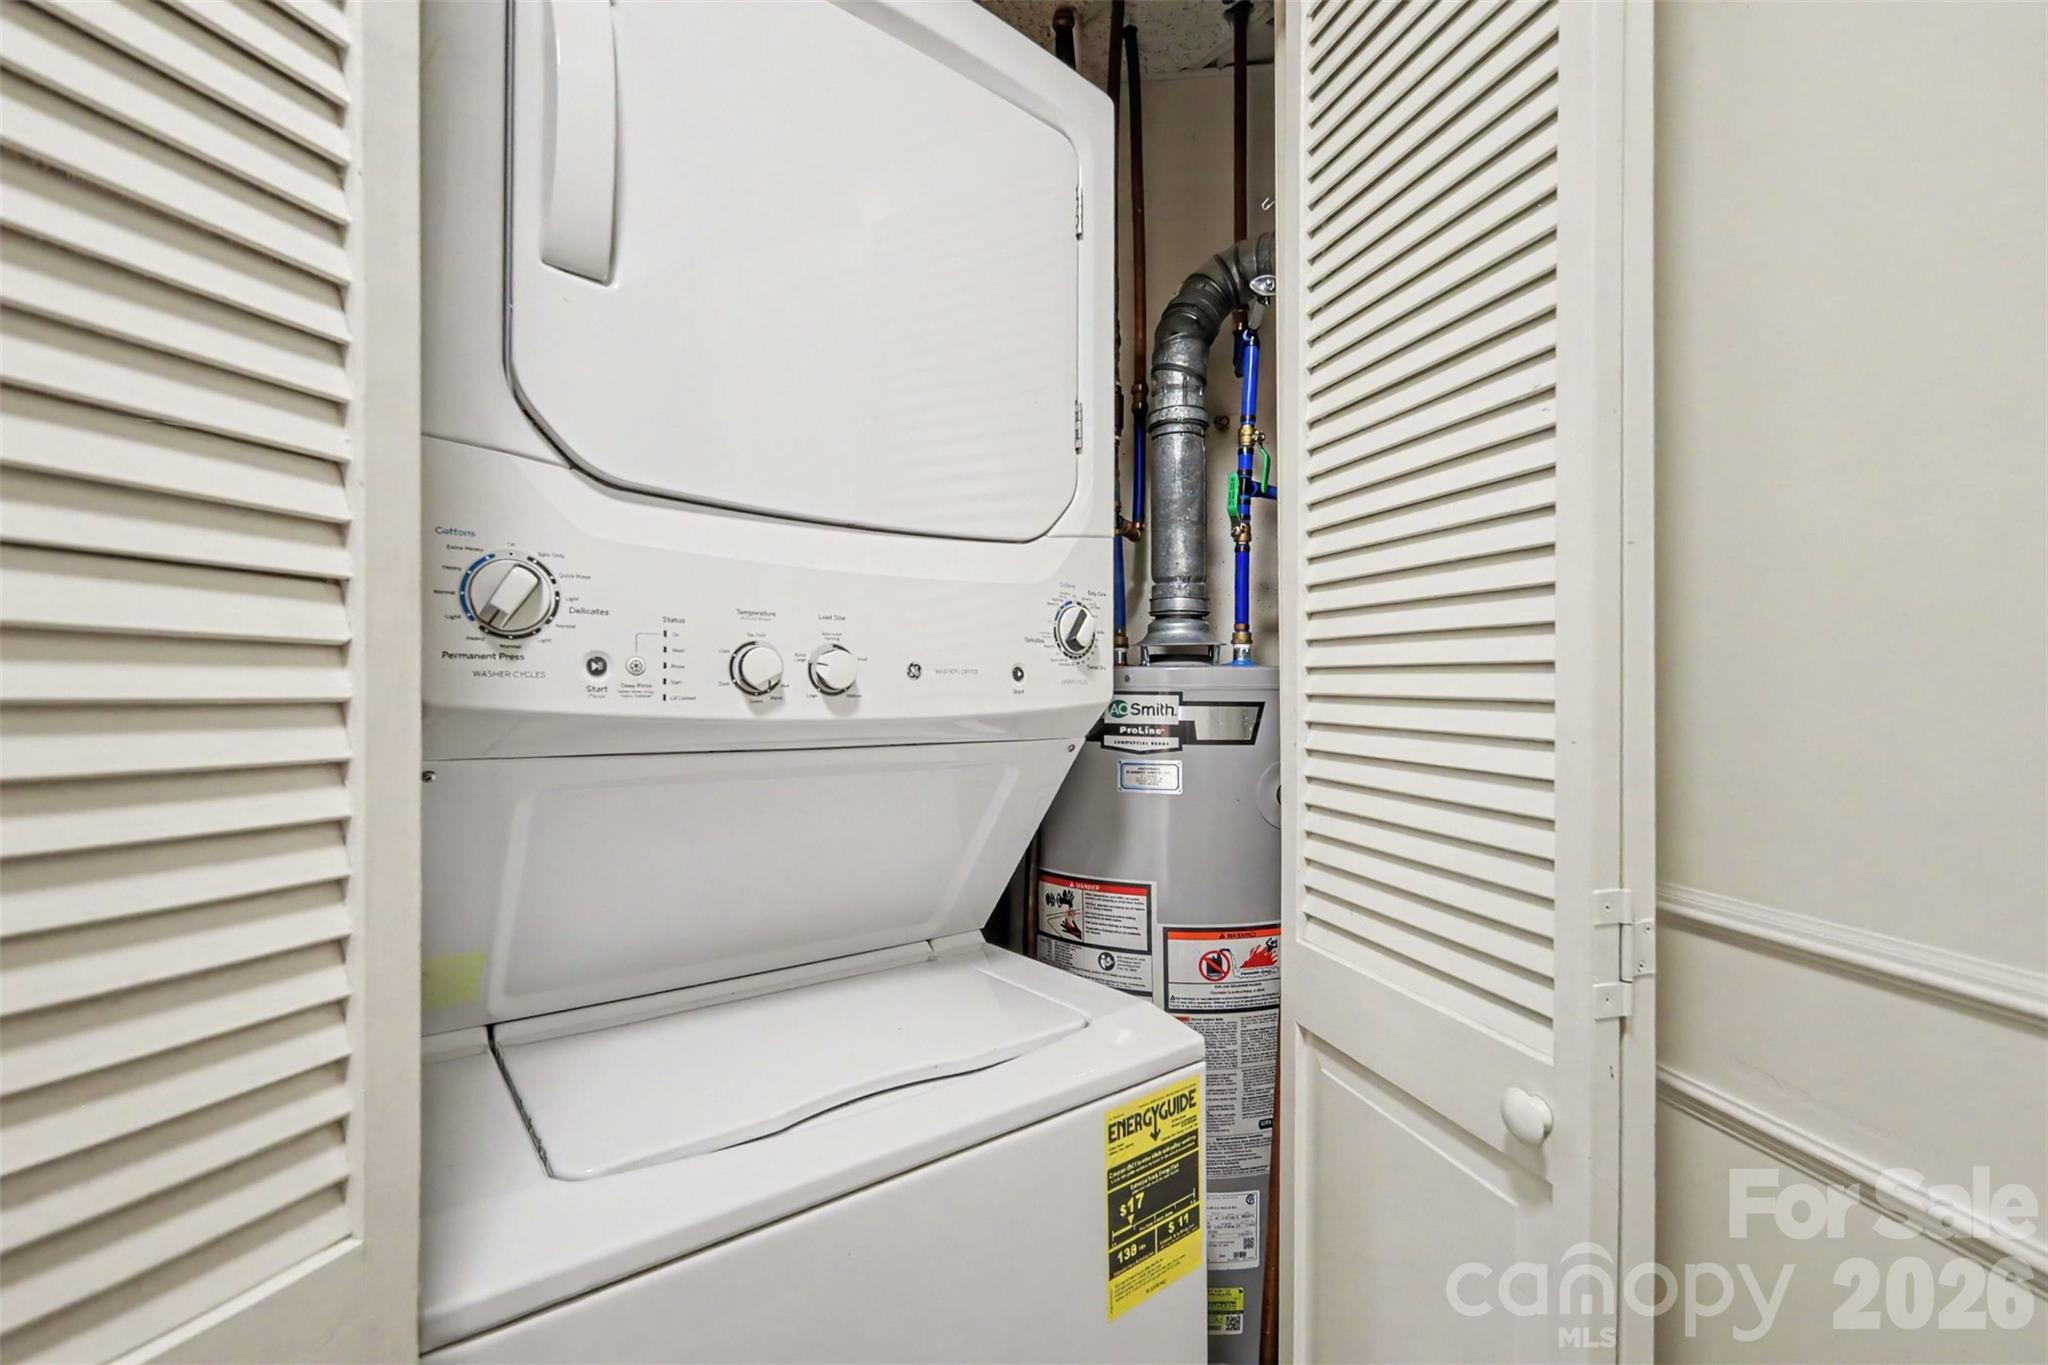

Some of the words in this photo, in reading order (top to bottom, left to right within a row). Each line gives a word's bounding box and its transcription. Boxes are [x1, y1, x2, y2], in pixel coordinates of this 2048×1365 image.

[434, 526, 476, 537] Cottons
[569, 607, 609, 616] Delicates
[736, 608, 777, 618] Temperature
[662, 616, 686, 624] Status
[442, 651, 496, 661] Permanent
[499, 652, 525, 661] Press
[472, 670, 511, 678] WASHER
[513, 671, 546, 679] CYCLES
[586, 685, 608, 693] Start
[1120, 725, 1162, 735] ProLine
[1108, 1088, 1196, 1144] ENERGYGUIDE
[1117, 1244, 1137, 1263] 138
